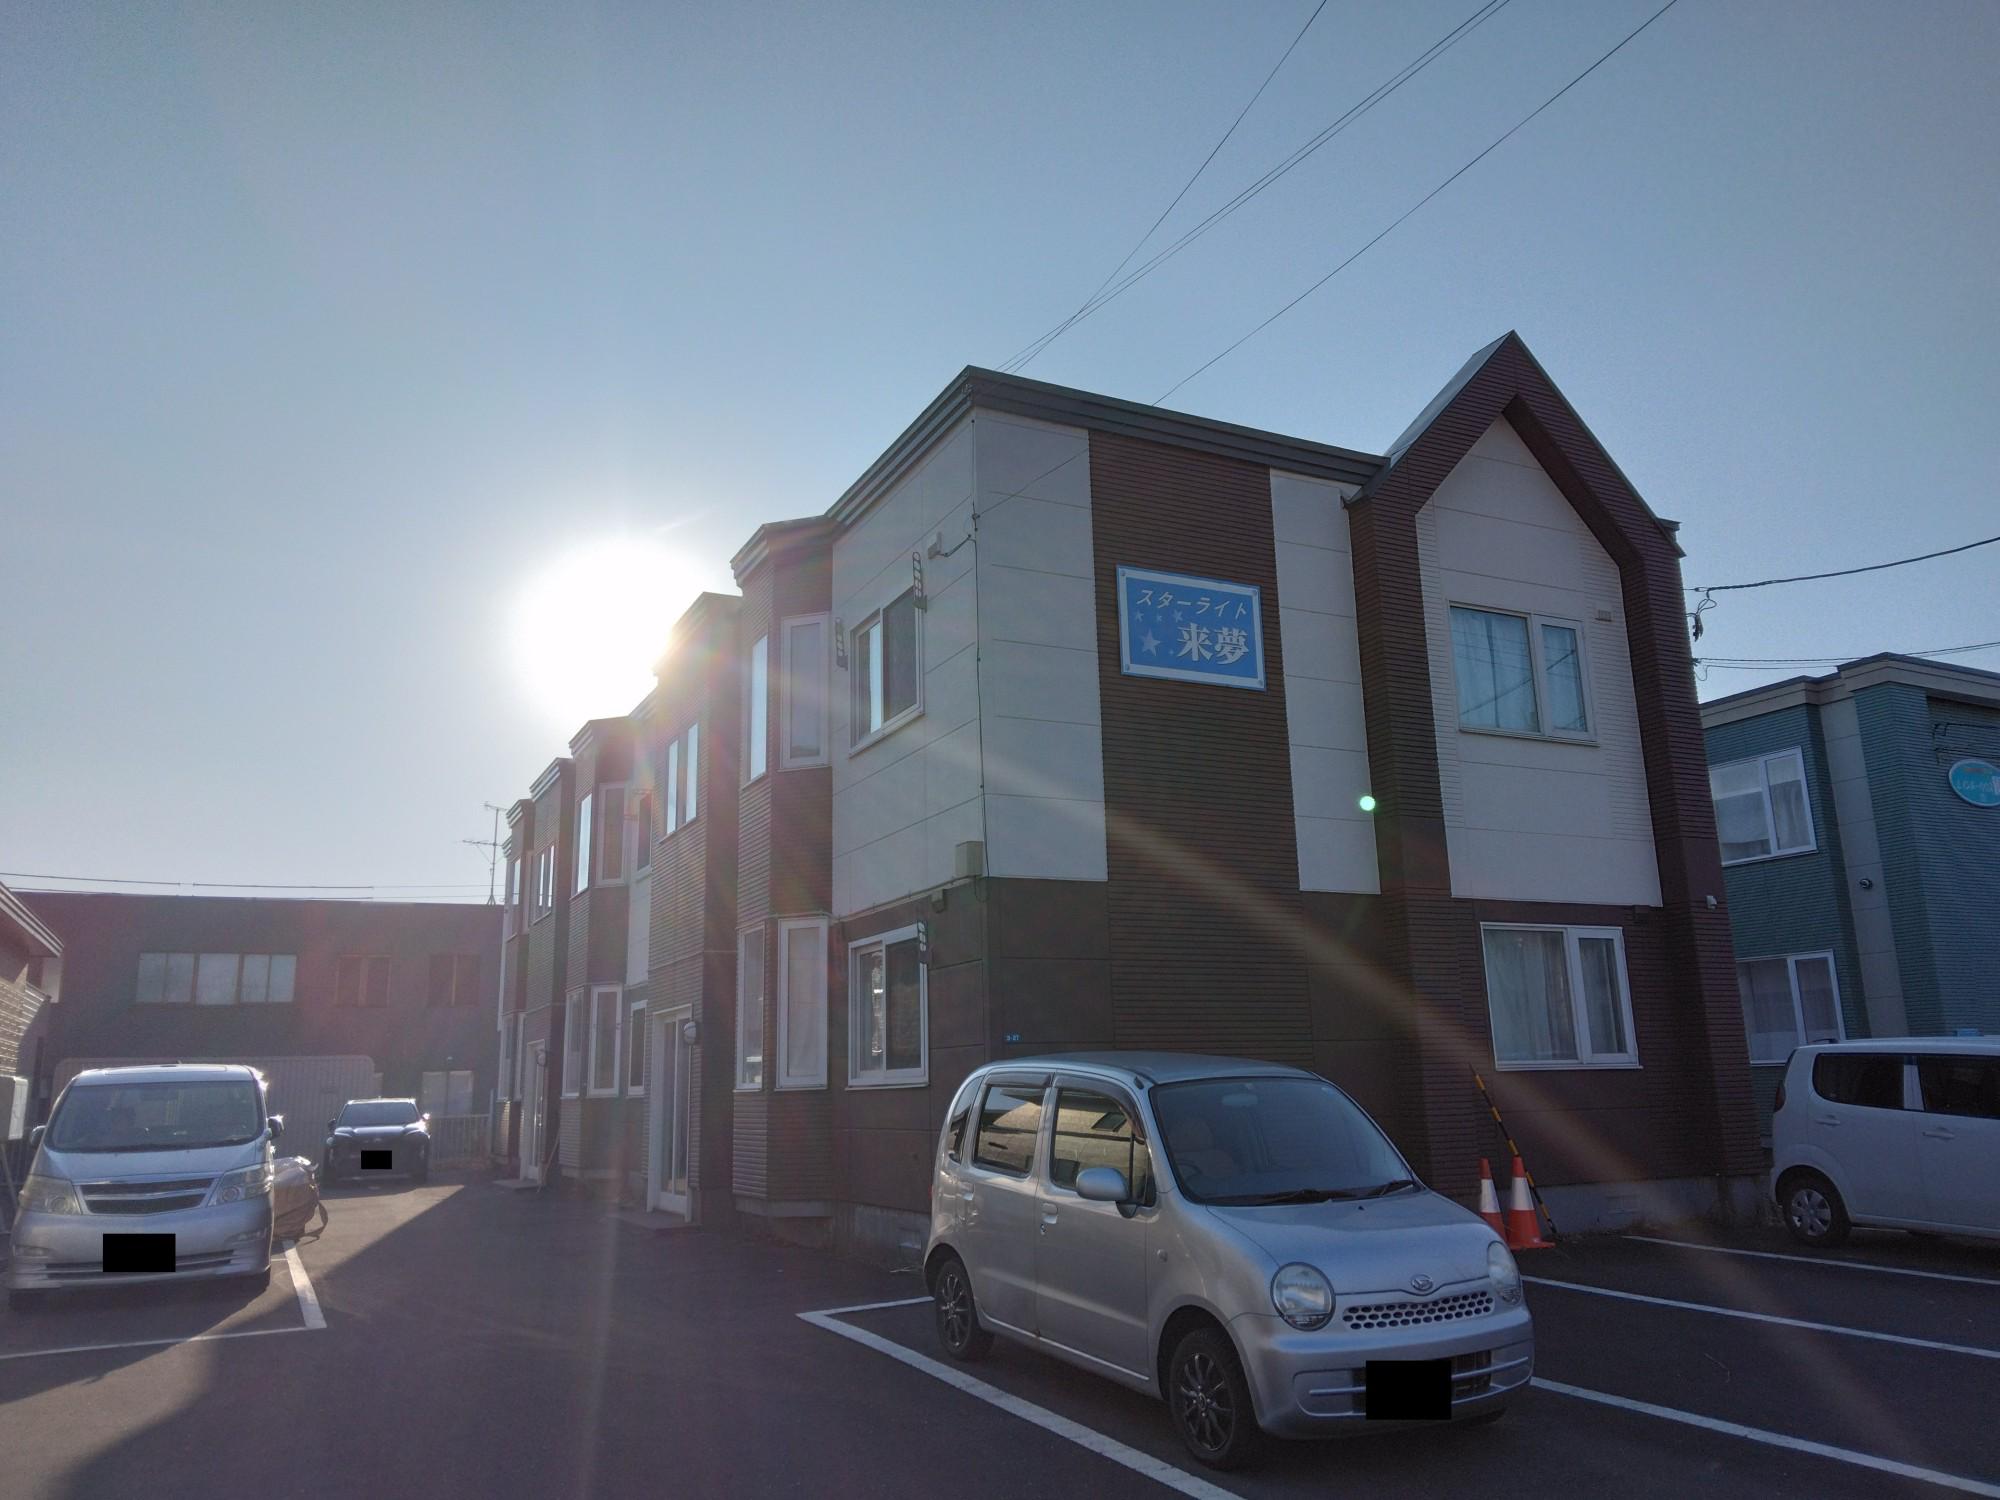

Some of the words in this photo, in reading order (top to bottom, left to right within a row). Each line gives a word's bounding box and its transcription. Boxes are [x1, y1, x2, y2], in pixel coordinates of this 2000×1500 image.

[1136, 589, 1247, 620] スターライト
[1177, 622, 1249, 665] 来夢
